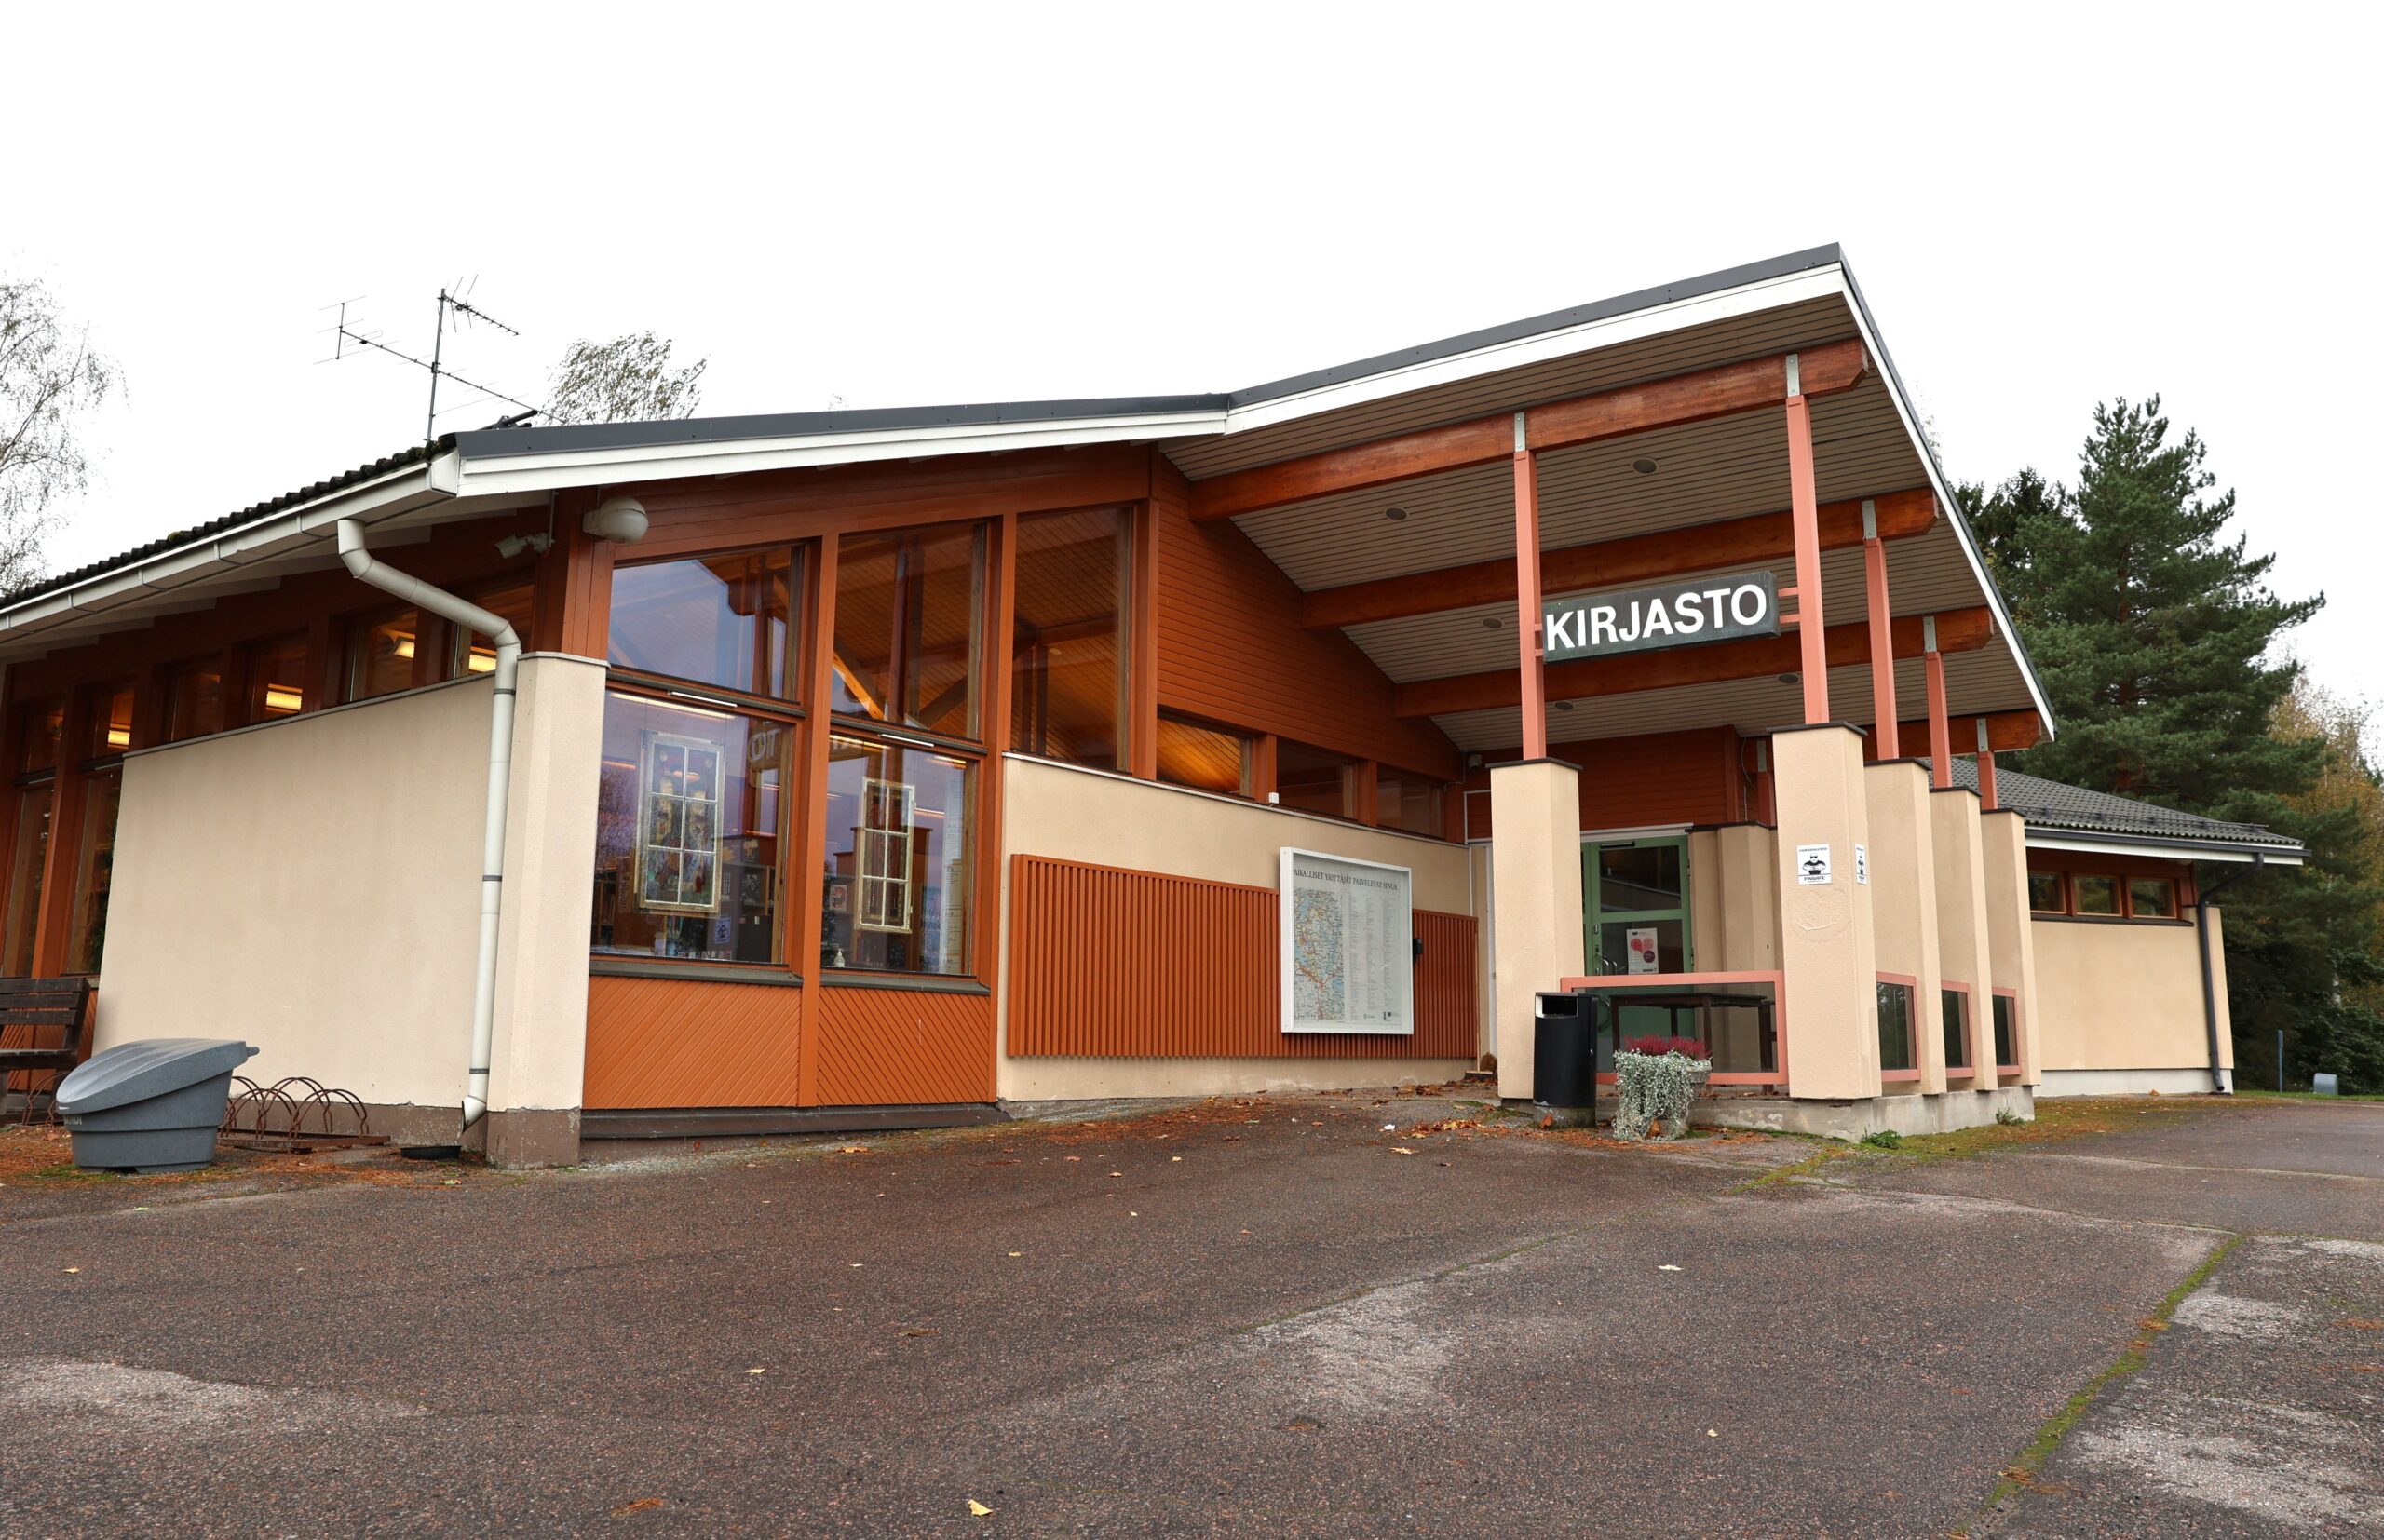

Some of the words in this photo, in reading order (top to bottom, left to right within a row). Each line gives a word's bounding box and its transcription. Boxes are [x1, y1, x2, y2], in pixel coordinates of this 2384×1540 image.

[1546, 584, 1767, 651] KIRJASTO
[1353, 877, 1382, 888] PALVELEVAT
[1383, 881, 1398, 891] SINUA
